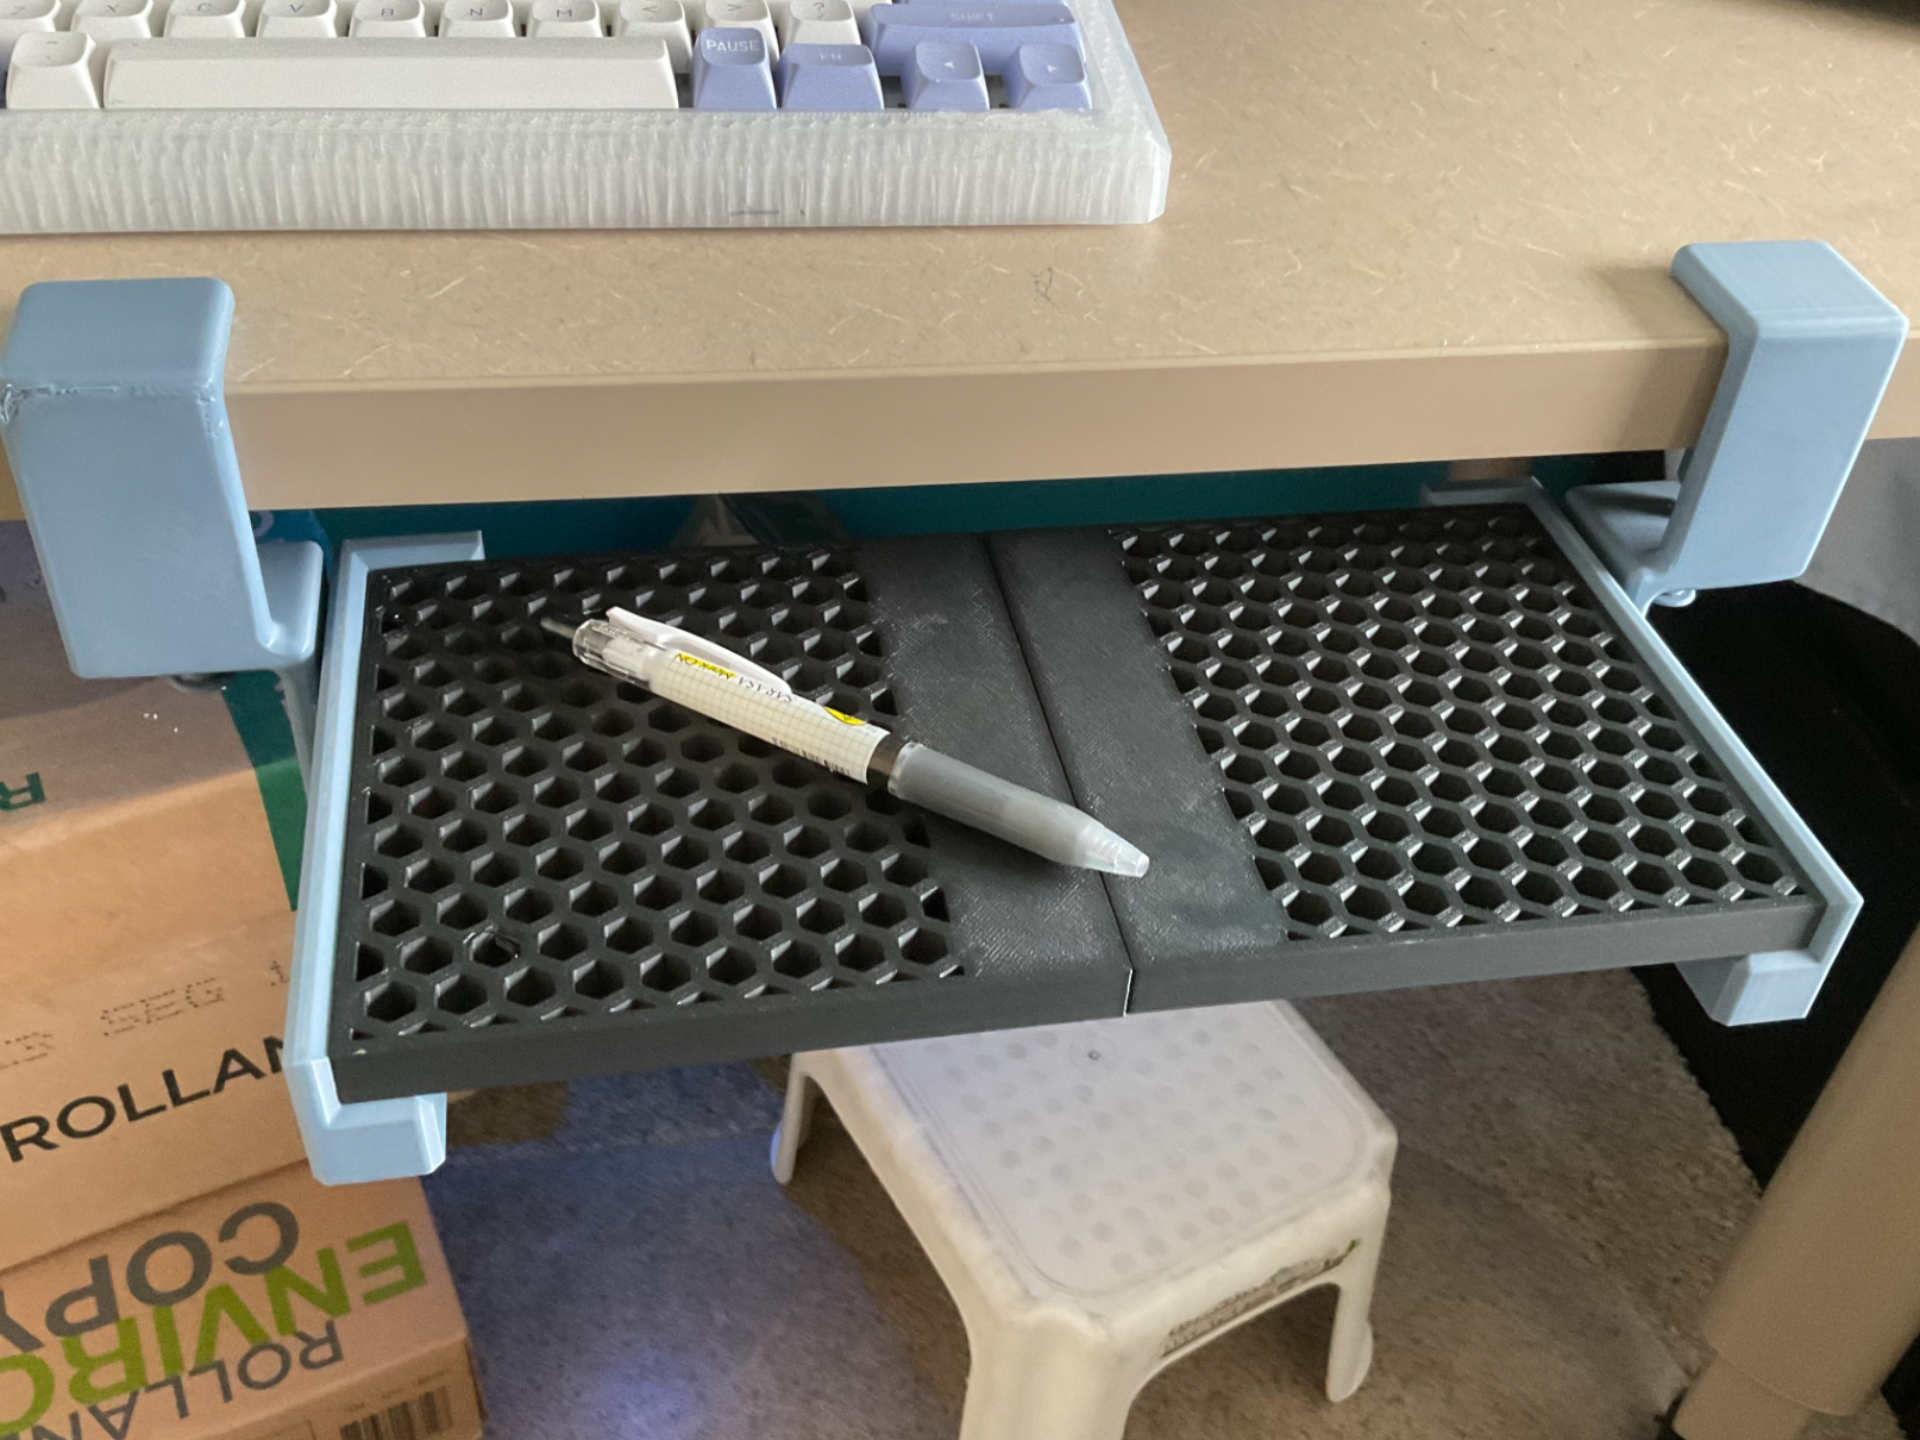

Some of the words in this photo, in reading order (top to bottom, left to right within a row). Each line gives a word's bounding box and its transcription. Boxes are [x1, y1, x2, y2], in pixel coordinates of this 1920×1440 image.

[469, 8, 483, 17] N
[556, 9, 572, 18] M
[950, 13, 994, 22] SHIFT
[706, 38, 760, 53] PAUSE
[100, 977, 225, 1037] SEG
[0, 1320, 344, 1440] ROLLA
